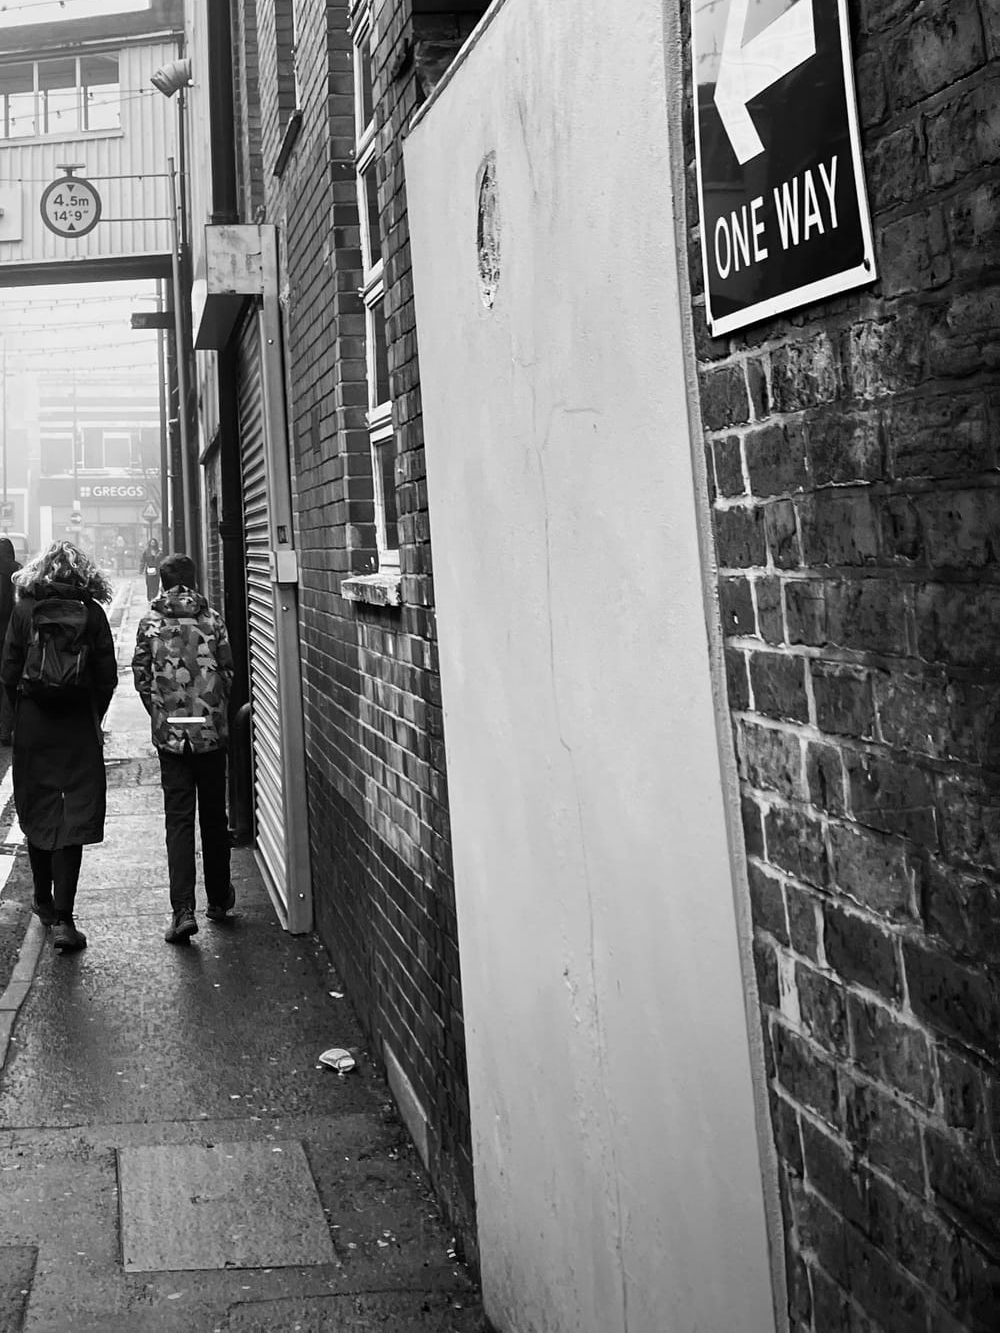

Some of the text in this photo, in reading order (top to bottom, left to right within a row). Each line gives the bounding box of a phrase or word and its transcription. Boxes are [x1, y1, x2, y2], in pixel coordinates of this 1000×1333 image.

[53, 193, 89, 207] 4.5m
[714, 154, 838, 280] ONE WAY
[92, 486, 144, 497] GREGGS
